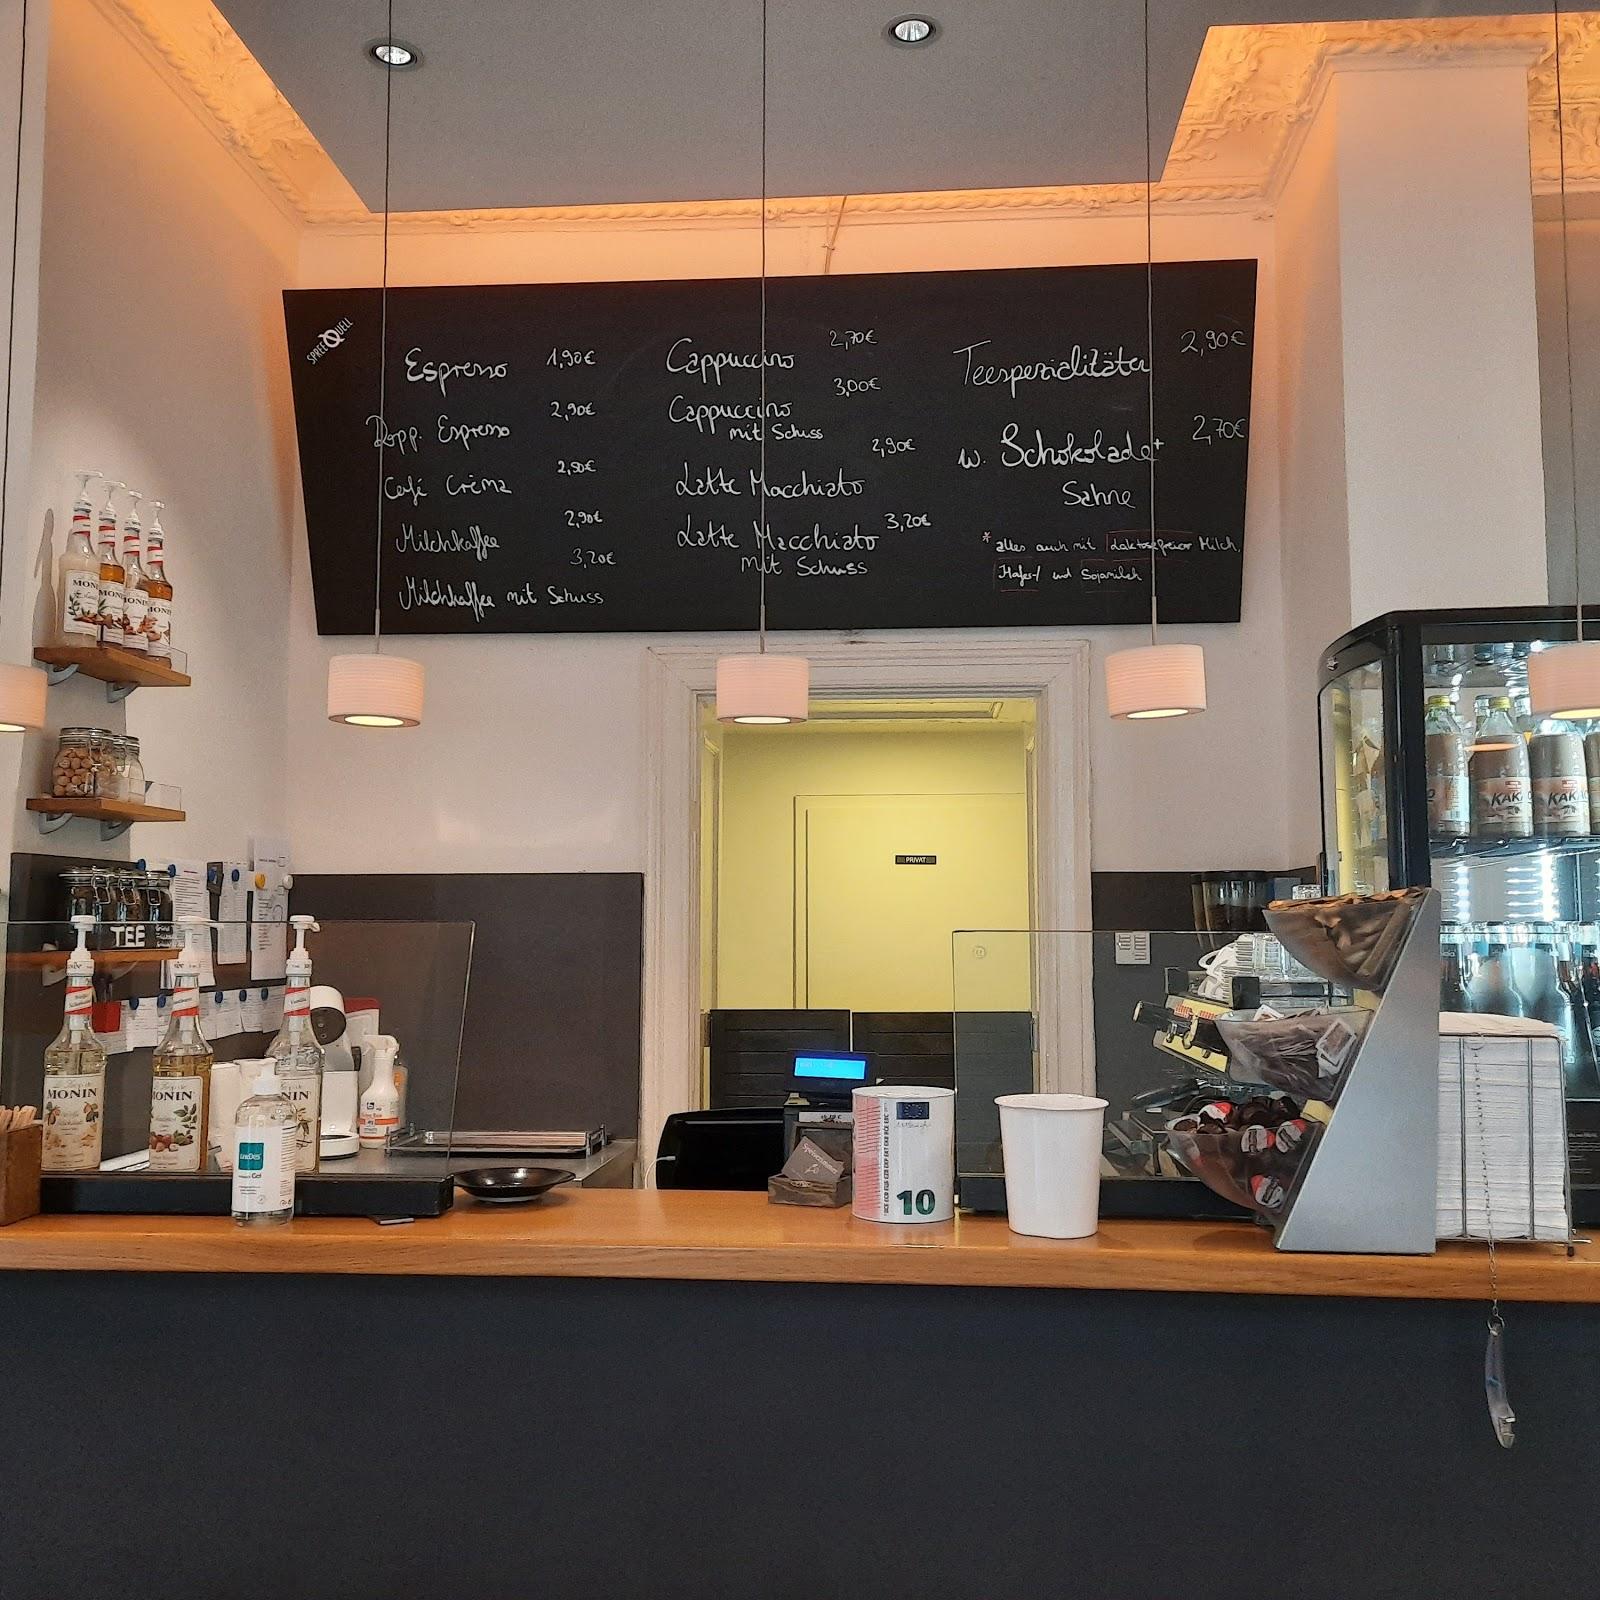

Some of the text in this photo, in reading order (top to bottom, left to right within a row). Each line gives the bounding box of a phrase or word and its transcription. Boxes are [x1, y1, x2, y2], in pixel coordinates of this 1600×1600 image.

[829, 329, 878, 351] 2,70€
[1180, 330, 1247, 357] 2,90€
[545, 347, 596, 369] 1,90€
[666, 337, 795, 386] Cappuccino
[404, 347, 510, 397] Espresso
[833, 376, 881, 398] 3,00€
[550, 401, 596, 421] 2,90€
[668, 394, 792, 435] Cappuccino
[437, 414, 511, 450] Espresso
[729, 423, 824, 442] mit Schuss
[1191, 414, 1246, 446] 2,70€
[871, 437, 917, 457] 2,90€
[556, 459, 597, 475] 2,50€
[384, 476, 428, 506] Café
[675, 461, 866, 499] Latte Macchiato
[1062, 479, 1136, 509] Sahne
[564, 510, 604, 528] 2,90€
[883, 512, 932, 533] 3,20€
[395, 523, 501, 562] Milchkaffee
[677, 514, 880, 551] Latte Macchiato
[1036, 538, 1069, 553] auch
[1073, 536, 1097, 551] mit
[569, 550, 617, 569] 3,20€
[741, 552, 869, 577] mit Schuss
[72, 579, 98, 591] MON
[1052, 567, 1073, 581] und
[1080, 565, 1143, 585] Sojamilch
[99, 588, 124, 599] MON
[399, 575, 604, 623] Milchkaffee mit Schuss
[905, 856, 927, 864] PRIVAT
[110, 925, 145, 948] TEE
[47, 1087, 98, 1100] MONIN
[281, 1090, 310, 1101] NIN
[896, 1189, 936, 1216] 10
